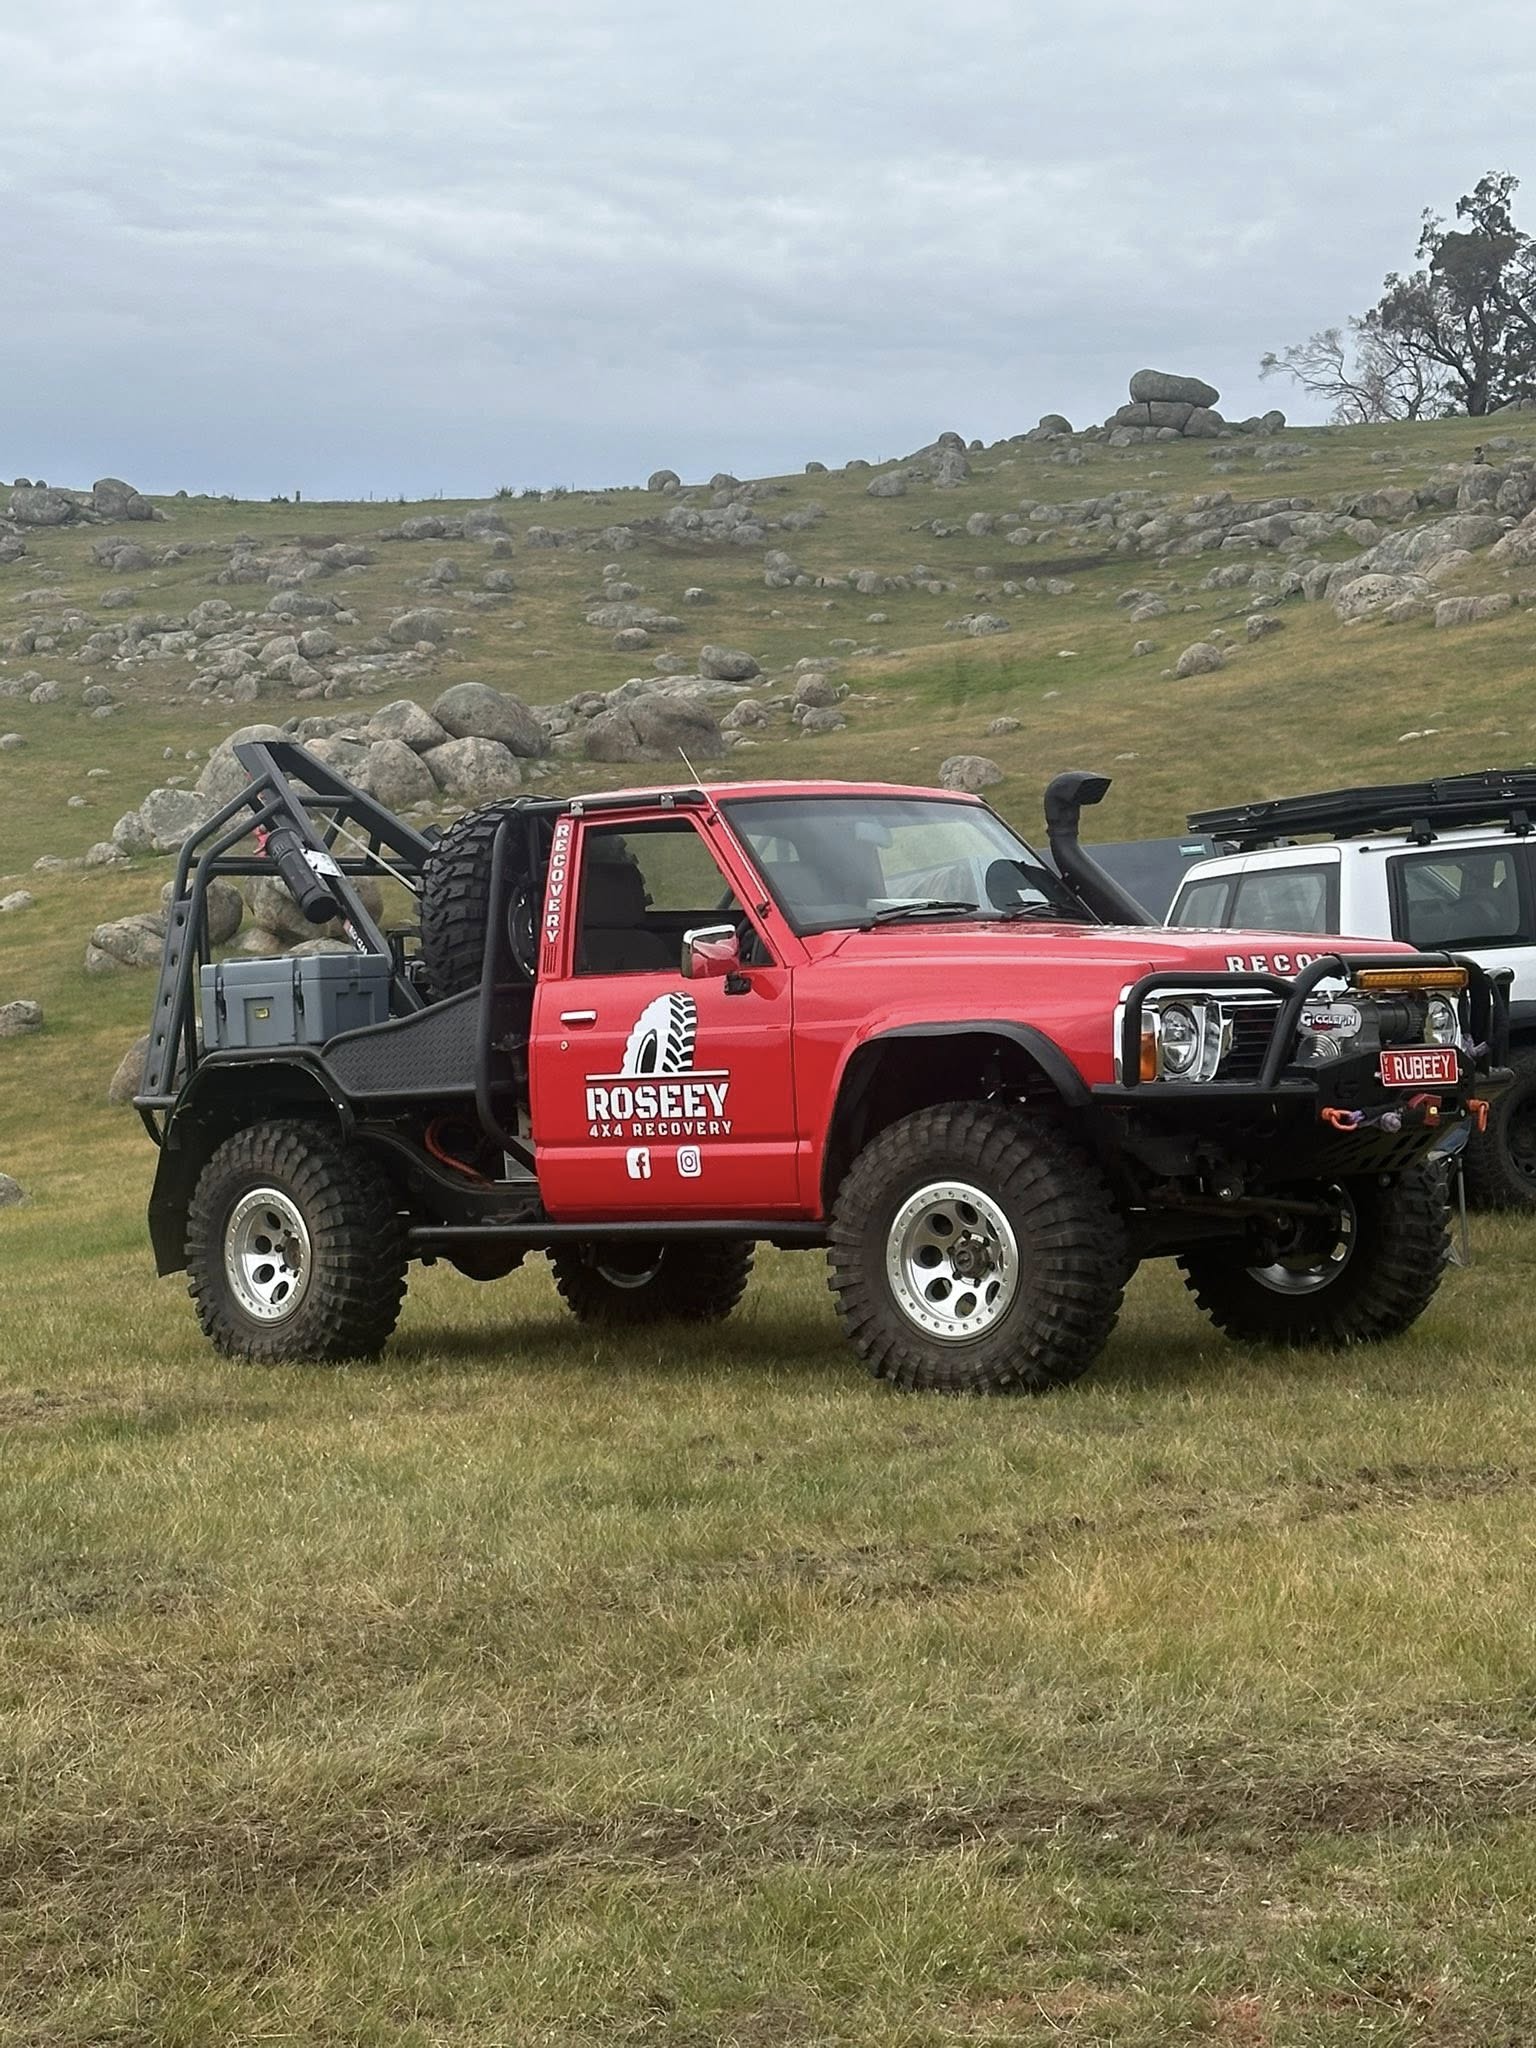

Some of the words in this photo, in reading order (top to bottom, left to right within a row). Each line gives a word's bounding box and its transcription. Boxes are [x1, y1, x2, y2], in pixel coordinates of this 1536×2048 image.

[546, 824, 570, 943] RECOVERY
[1226, 953, 1326, 972] RECO
[1393, 1055, 1450, 1080] RUBEEY
[586, 1082, 729, 1121] ROSEEY
[589, 1123, 624, 1138] 4X4
[632, 1120, 732, 1137] RECOVERY
